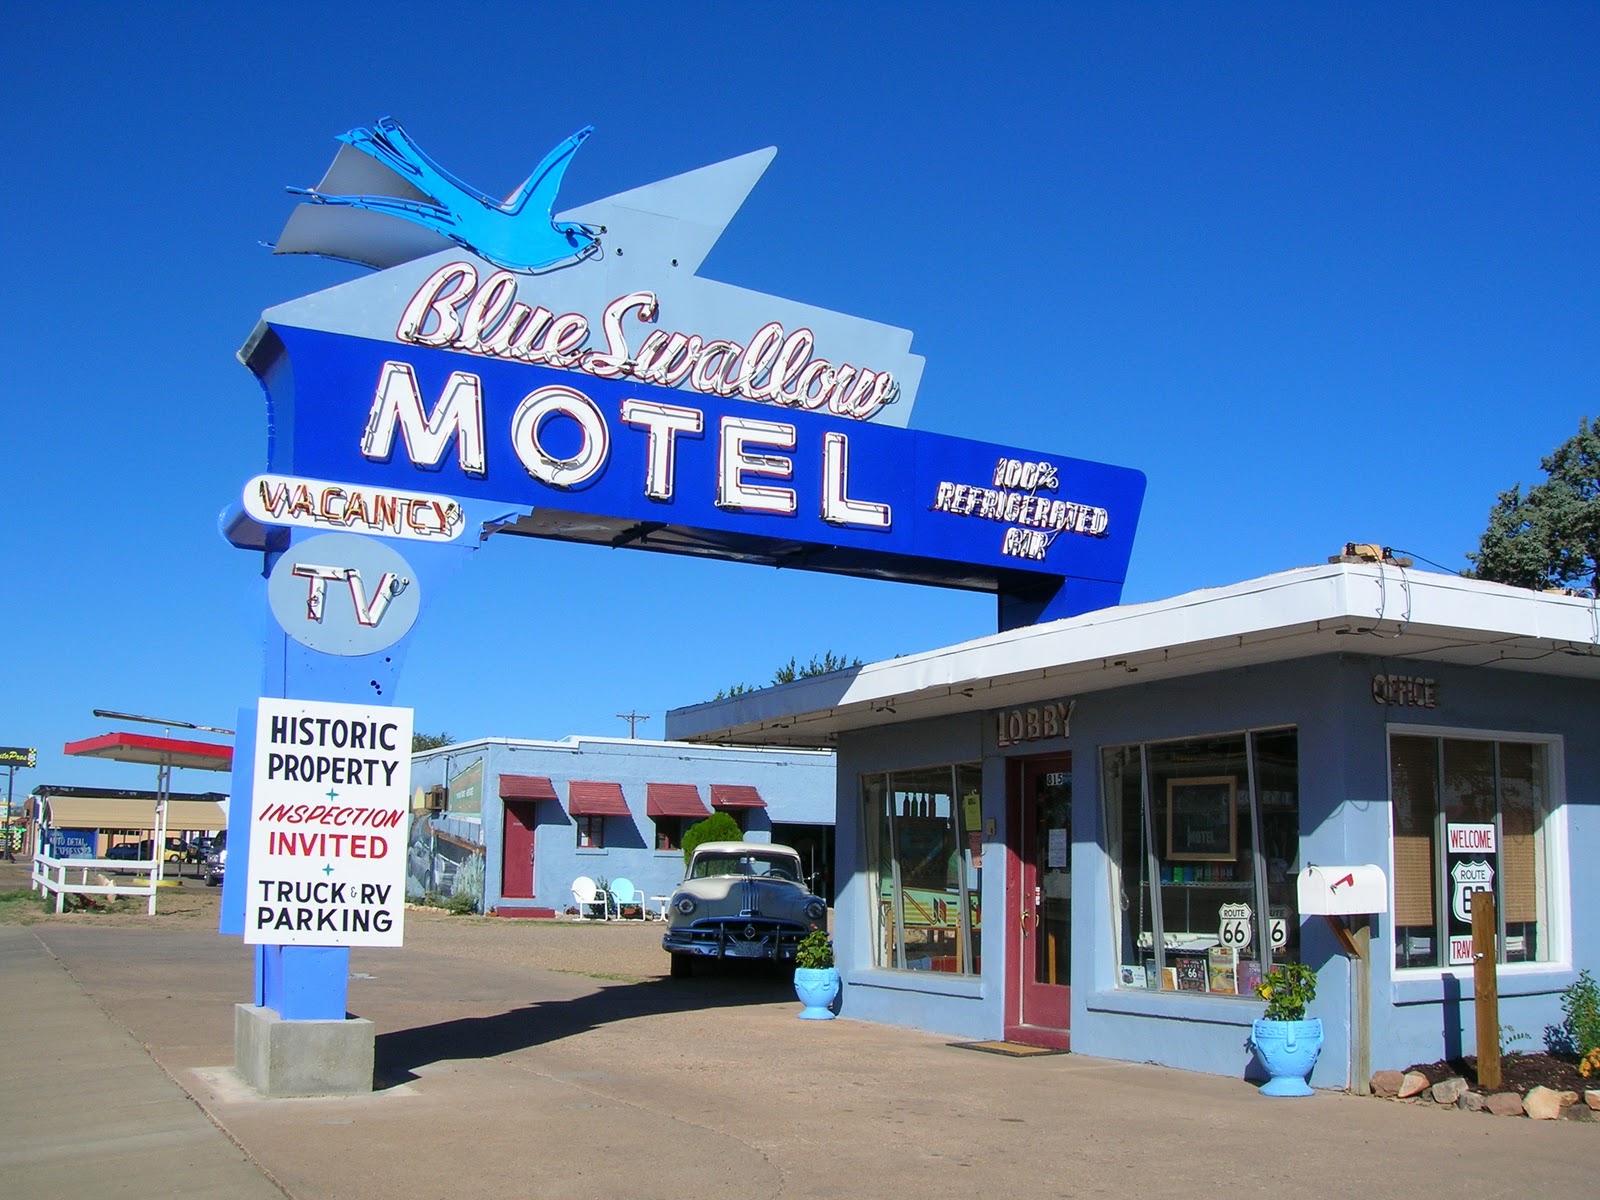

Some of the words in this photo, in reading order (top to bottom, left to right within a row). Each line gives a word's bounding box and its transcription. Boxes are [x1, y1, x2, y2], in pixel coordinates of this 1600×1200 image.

[395, 261, 588, 368] Blue
[580, 290, 899, 420] Swallow
[360, 360, 893, 528] MOTEL
[994, 458, 1059, 490] 100%
[259, 480, 462, 534] VACANCY
[935, 481, 1109, 535] REFRIGERATED
[1002, 527, 1048, 560] AIR
[292, 563, 399, 627] TV
[1372, 674, 1436, 709] OFFICE
[271, 715, 398, 751] HISTORIC
[997, 700, 1077, 748] LOBBY
[268, 753, 399, 786] PROPERTY
[1047, 773, 1063, 786] 815
[259, 803, 404, 828] INSPECTION
[269, 832, 388, 859] INVITED
[1450, 830, 1492, 849] WELCOME
[1460, 869, 1486, 880] ROUTE
[259, 880, 346, 904] TRUCK
[350, 886, 357, 899] &
[361, 883, 392, 905] RV
[257, 907, 393, 932] PARKING
[1223, 909, 1245, 917] ROUTE
[1223, 920, 1245, 943] 66
[1271, 920, 1284, 943] 6
[1188, 968, 1198, 978] 66
